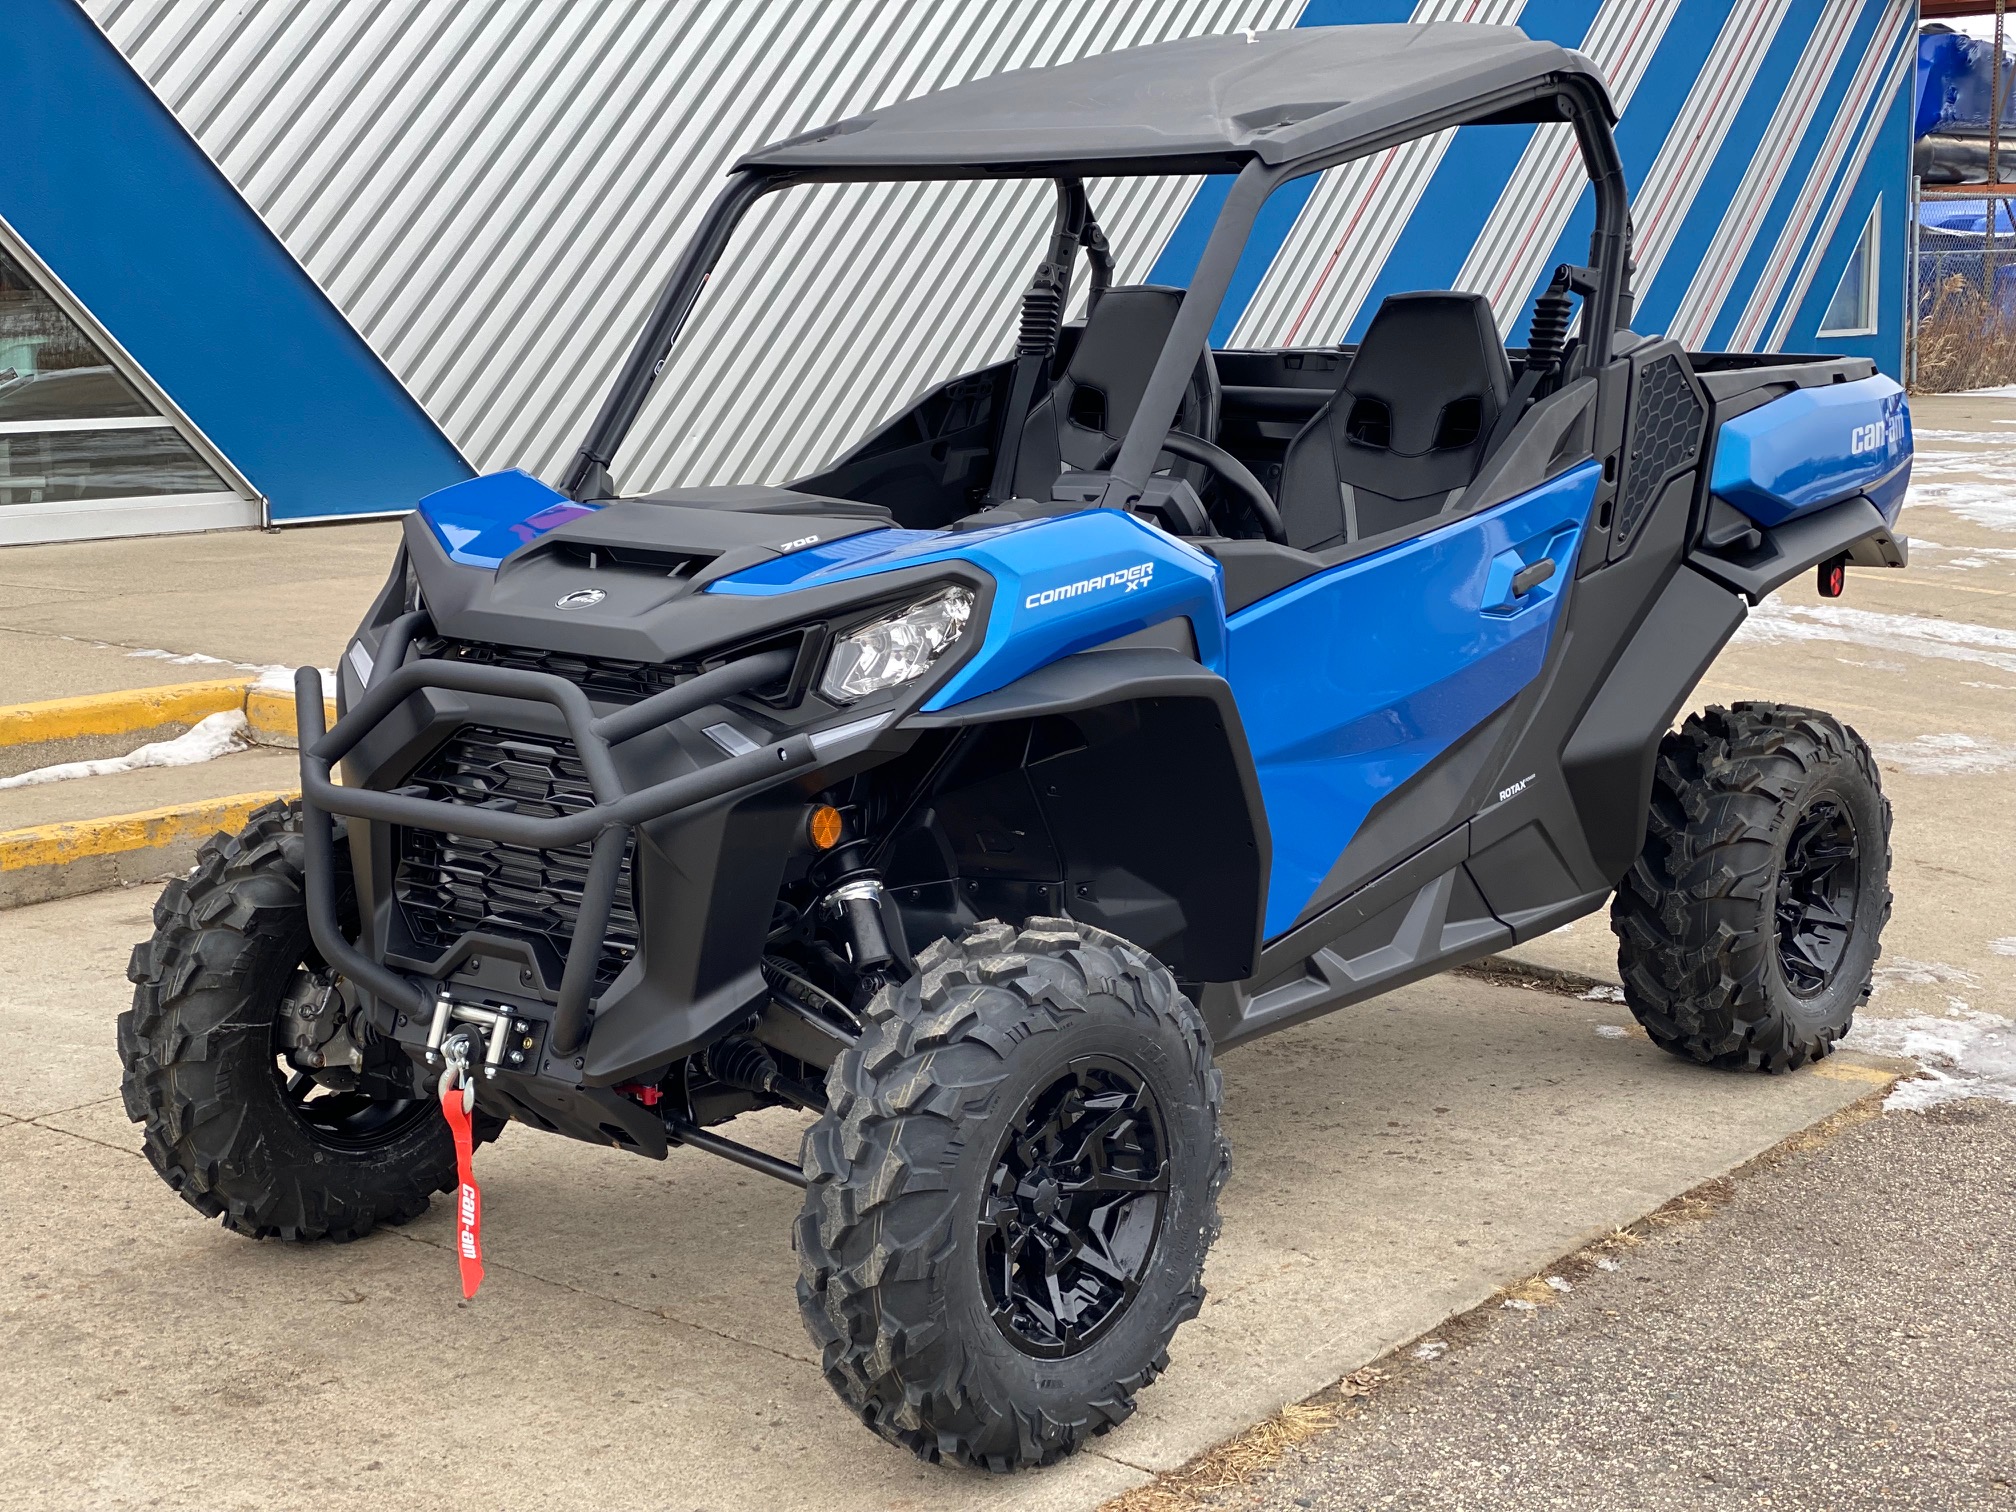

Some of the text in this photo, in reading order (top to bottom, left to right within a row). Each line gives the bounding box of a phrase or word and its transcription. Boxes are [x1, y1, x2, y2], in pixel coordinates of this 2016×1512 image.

[1851, 412, 1905, 455] can-am
[780, 535, 819, 551] 700
[1025, 562, 1155, 609] COMMANDER
[1124, 576, 1153, 593] XT
[1499, 779, 1527, 802] ROTAX
[461, 1183, 477, 1260] can-am
